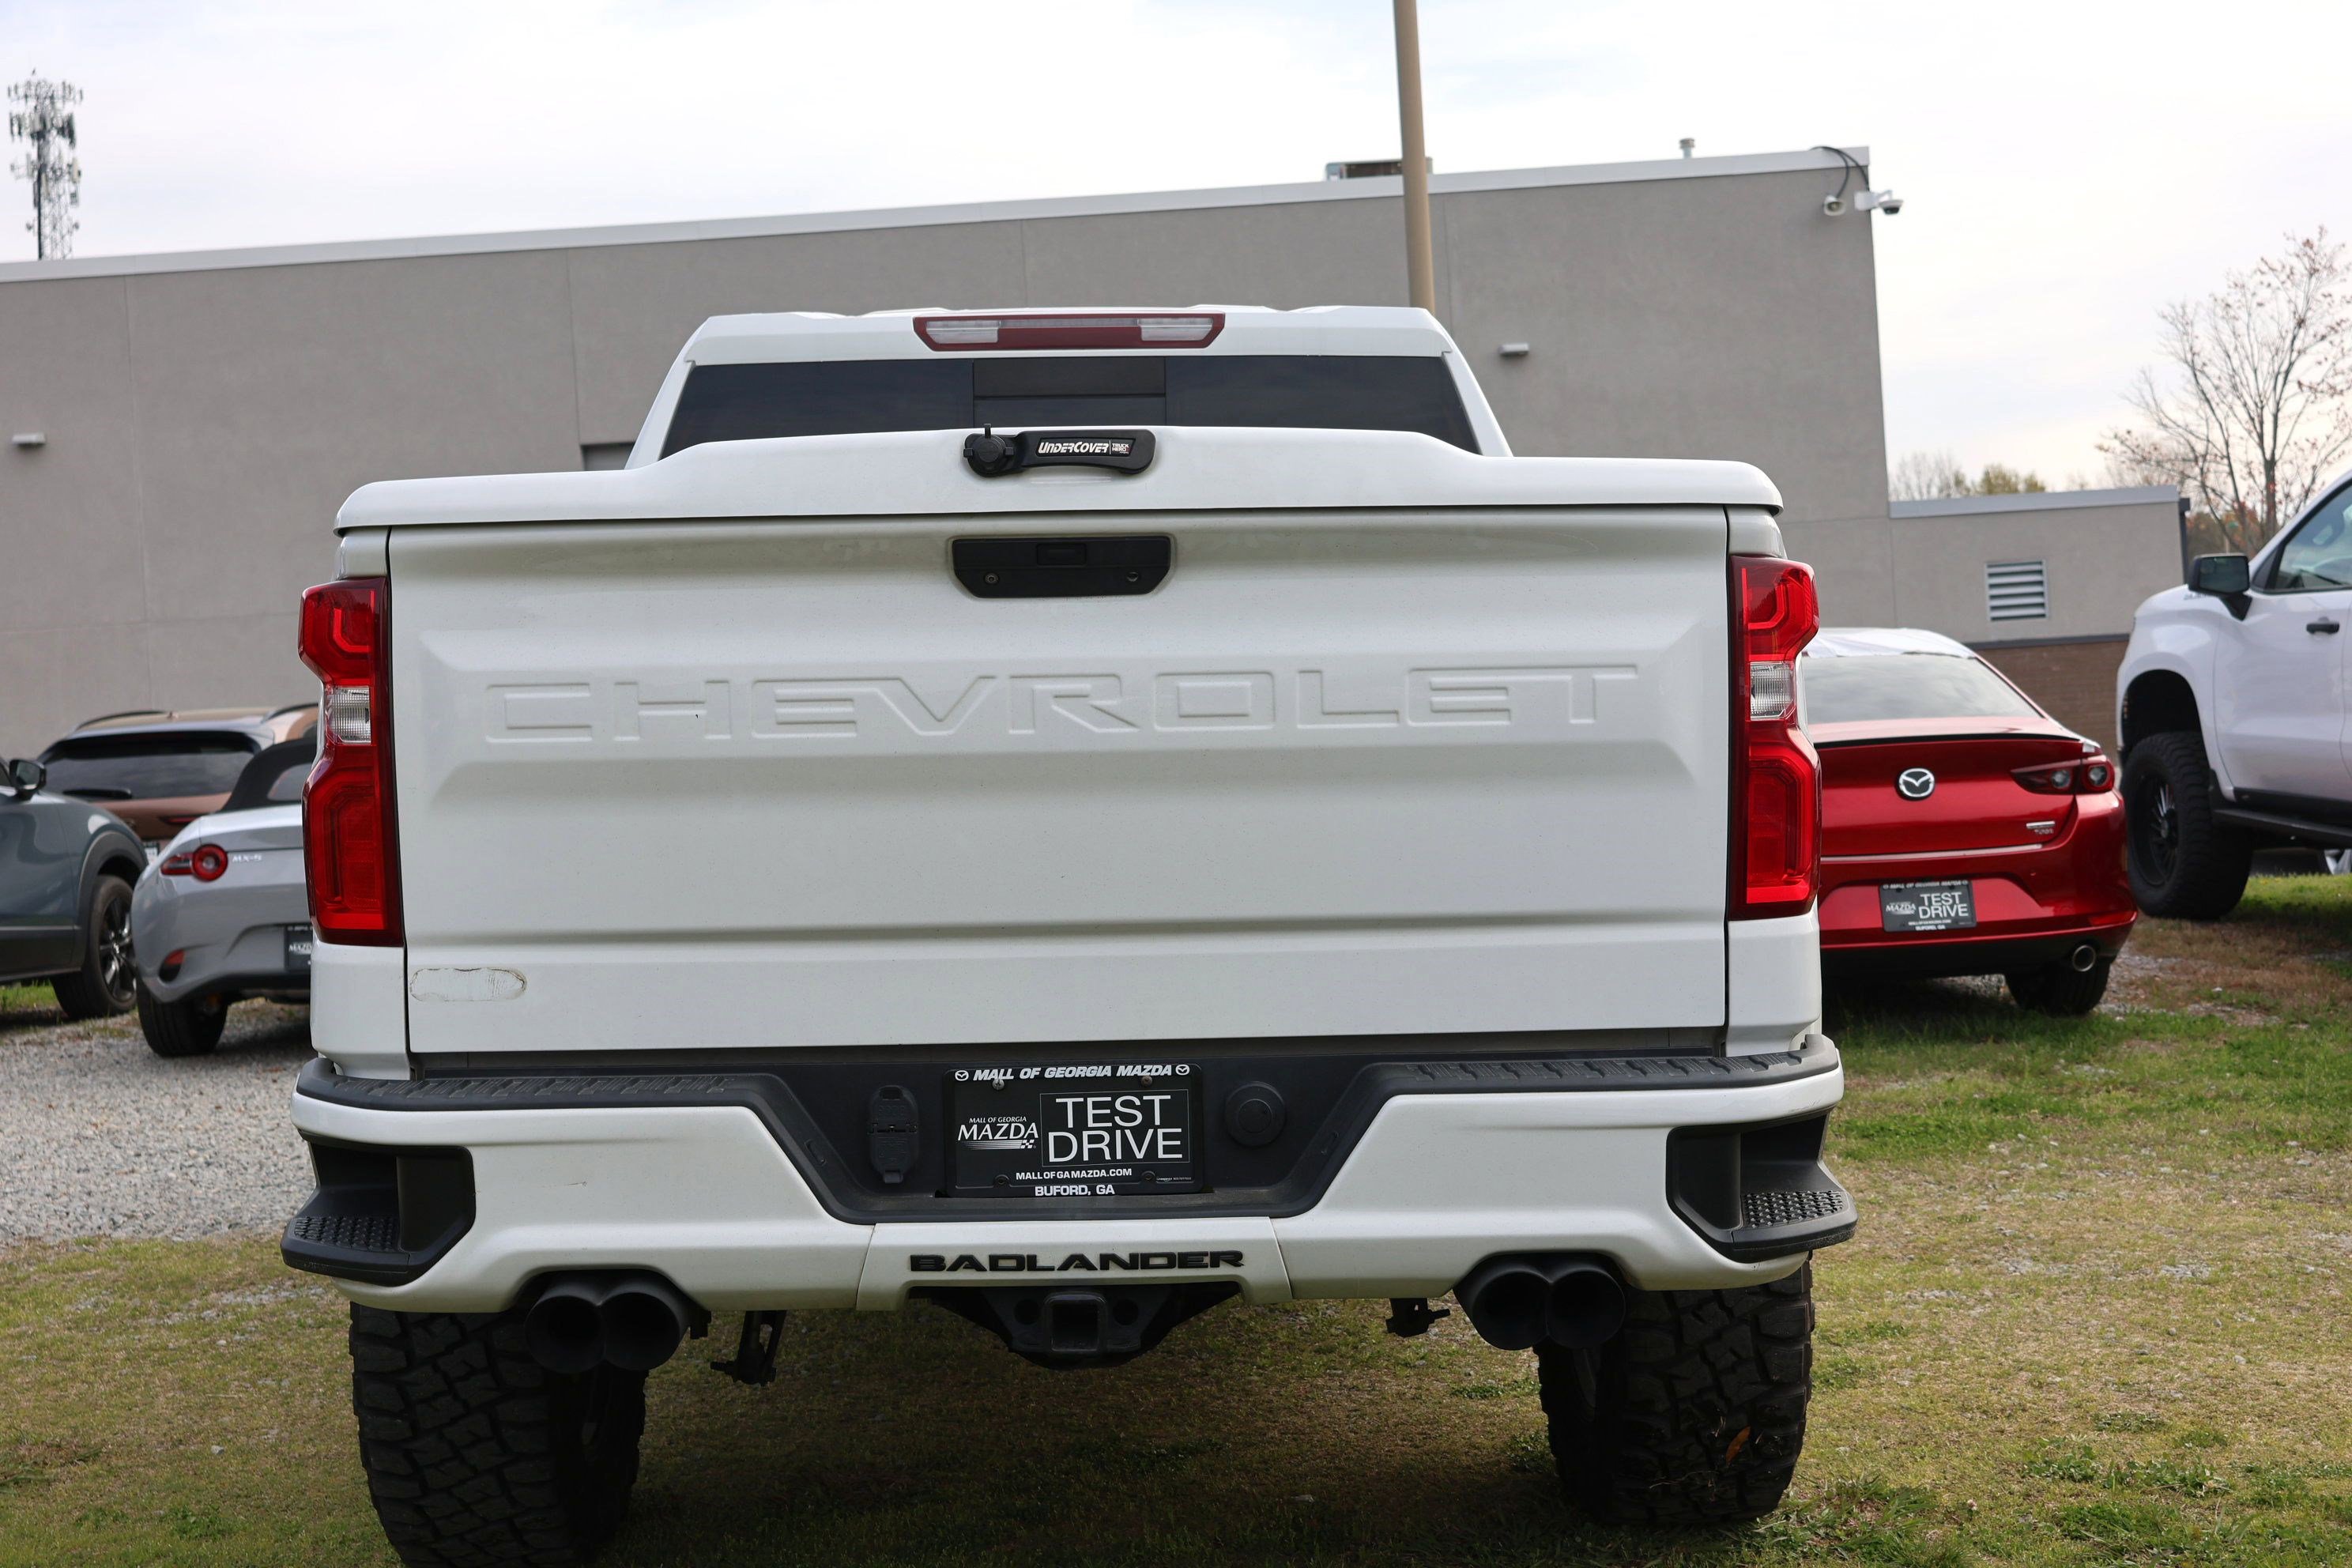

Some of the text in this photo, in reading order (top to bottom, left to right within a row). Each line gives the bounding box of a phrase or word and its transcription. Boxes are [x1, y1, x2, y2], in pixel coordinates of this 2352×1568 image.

[485, 665, 1638, 744] CHEVROLET
[1920, 891, 1962, 906] TEST
[1885, 903, 1917, 913] MAZDA
[1918, 903, 1969, 919] DRIVE
[973, 1065, 1172, 1081] MALL OF GEORGIA MAZDA
[1055, 1095, 1171, 1129] TEST
[957, 1122, 1039, 1141] MAZDA
[1048, 1128, 1183, 1163] DRIVE
[1035, 1184, 1115, 1197] BUFORD, GA
[910, 1250, 1246, 1272] BADLANDER
